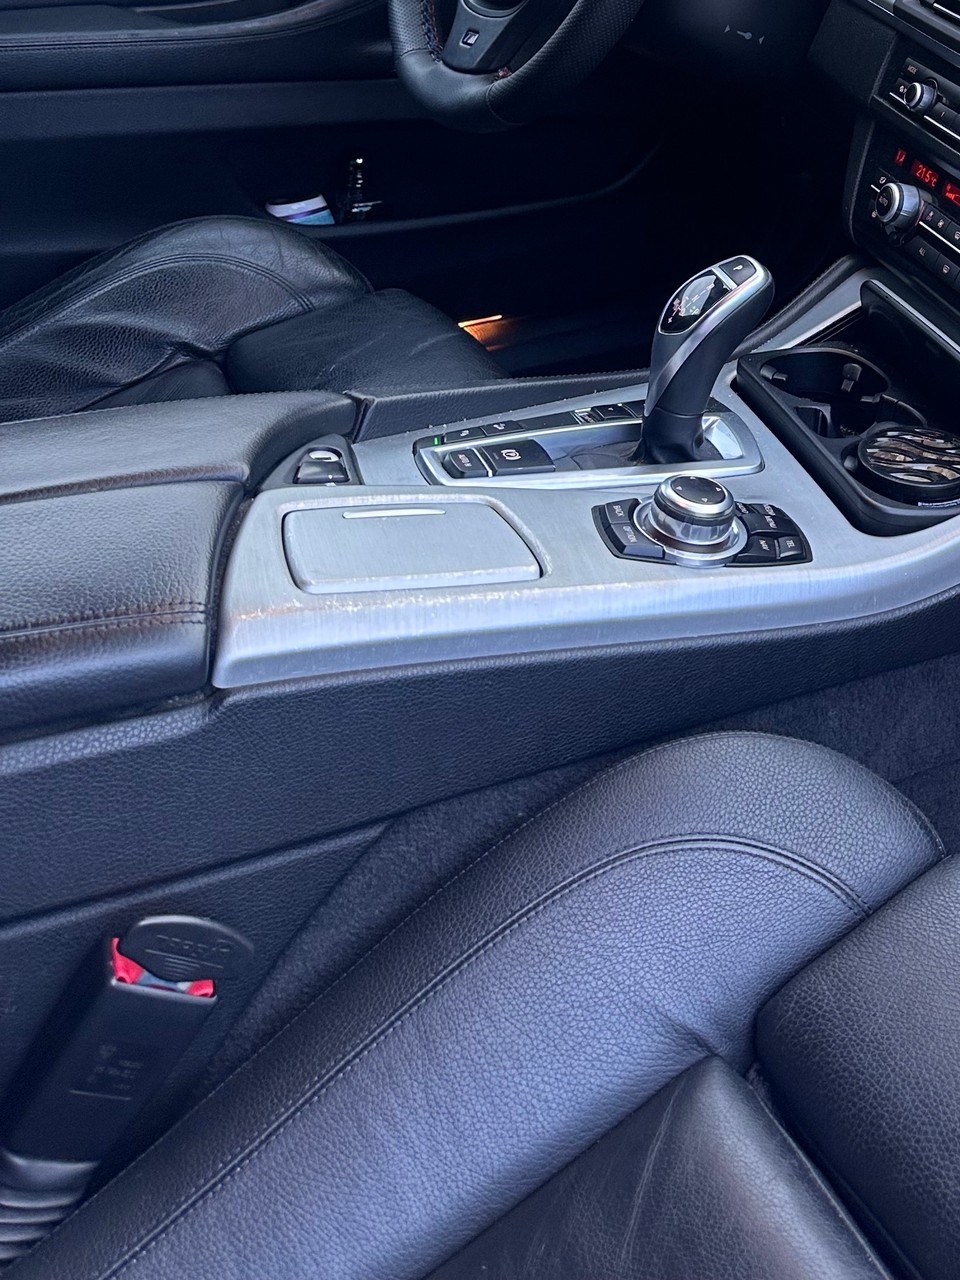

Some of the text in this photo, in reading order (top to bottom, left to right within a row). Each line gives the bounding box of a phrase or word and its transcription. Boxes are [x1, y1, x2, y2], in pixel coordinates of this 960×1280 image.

[916, 164, 932, 182] 21.5
[613, 505, 625, 517] BACK
[764, 515, 777, 529] MENU
[622, 525, 638, 543] OPTION
[759, 539, 770, 551] NAV
[786, 539, 795, 548] TEL
